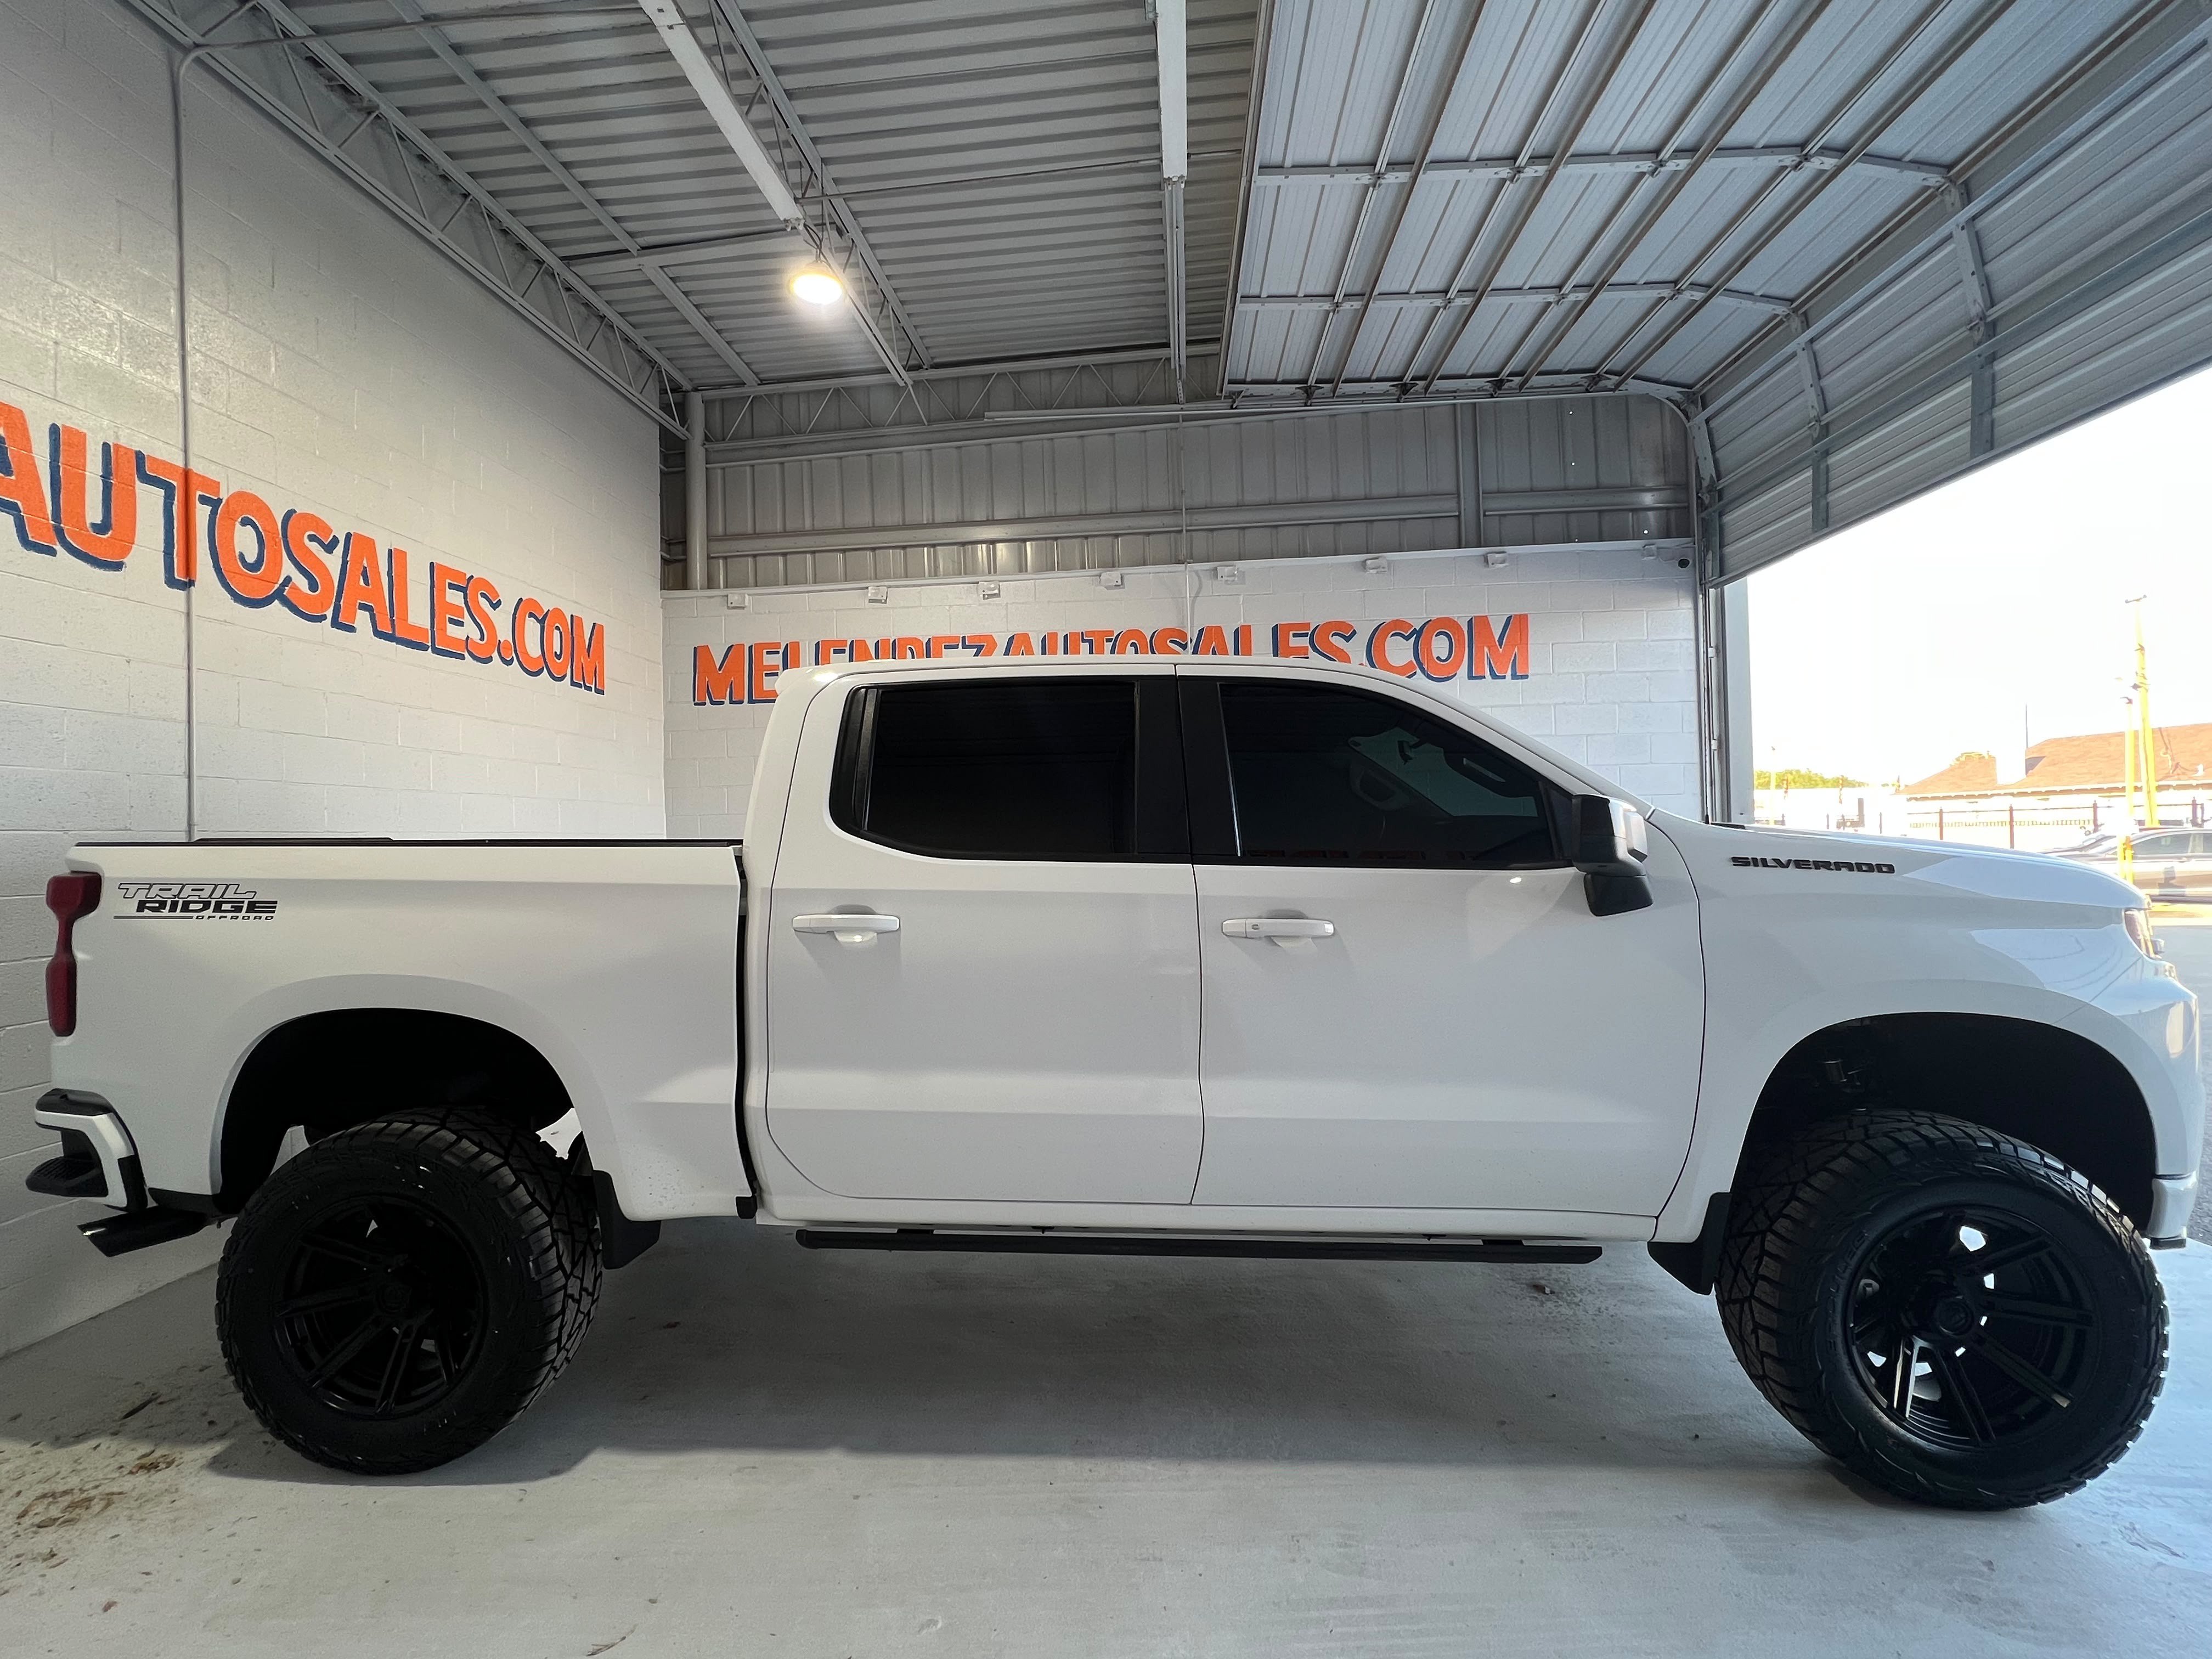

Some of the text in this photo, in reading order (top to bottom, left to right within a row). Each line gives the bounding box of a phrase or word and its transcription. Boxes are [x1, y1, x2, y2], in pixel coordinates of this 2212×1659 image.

[1730, 856, 1895, 873] SILVERADO
[118, 883, 257, 899] TRAIL
[136, 900, 278, 913] RIDGE
